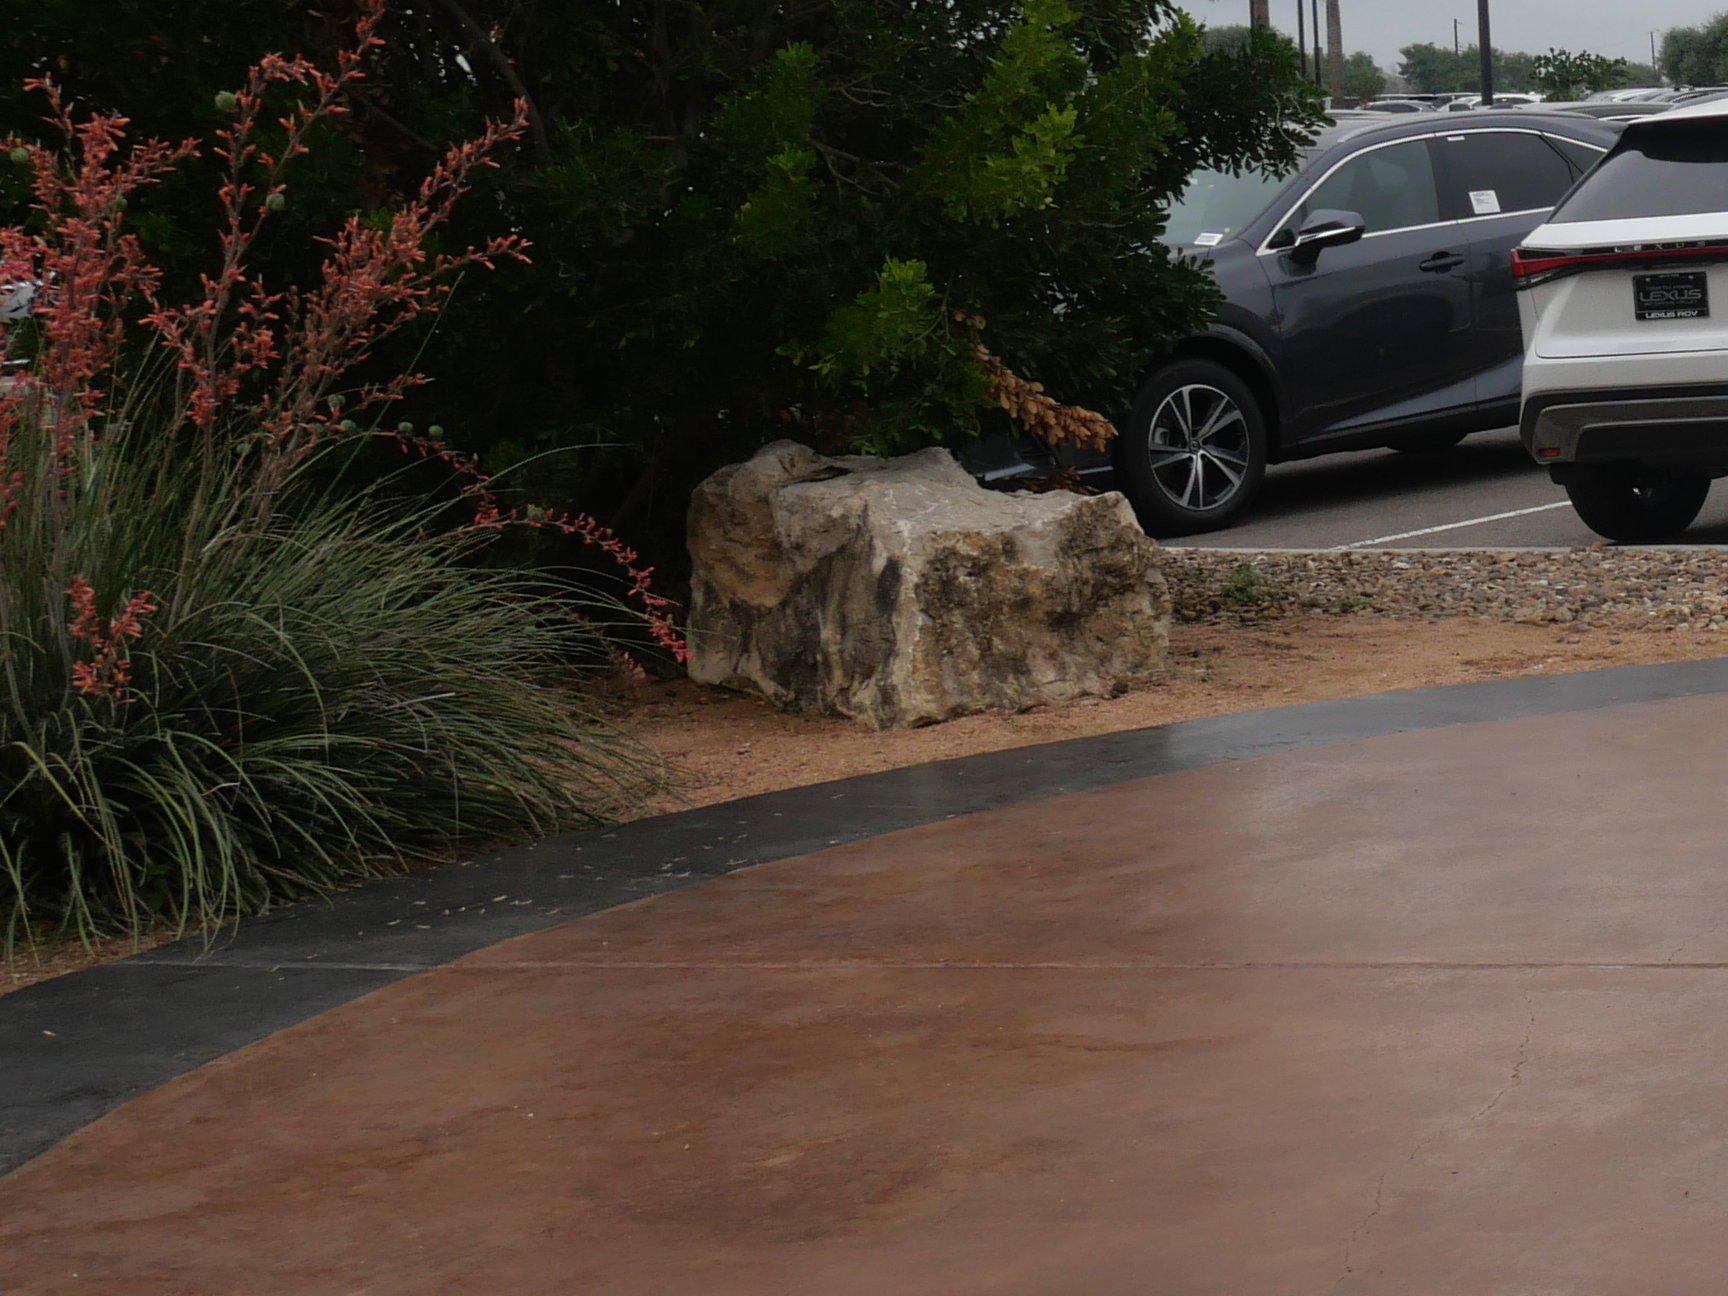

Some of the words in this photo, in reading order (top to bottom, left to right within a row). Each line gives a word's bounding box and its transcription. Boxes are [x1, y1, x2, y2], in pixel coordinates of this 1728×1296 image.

[1614, 241, 1706, 253] LEXUS
[1640, 289, 1702, 302] LEXUS
[1645, 311, 1676, 319] LEXUS
